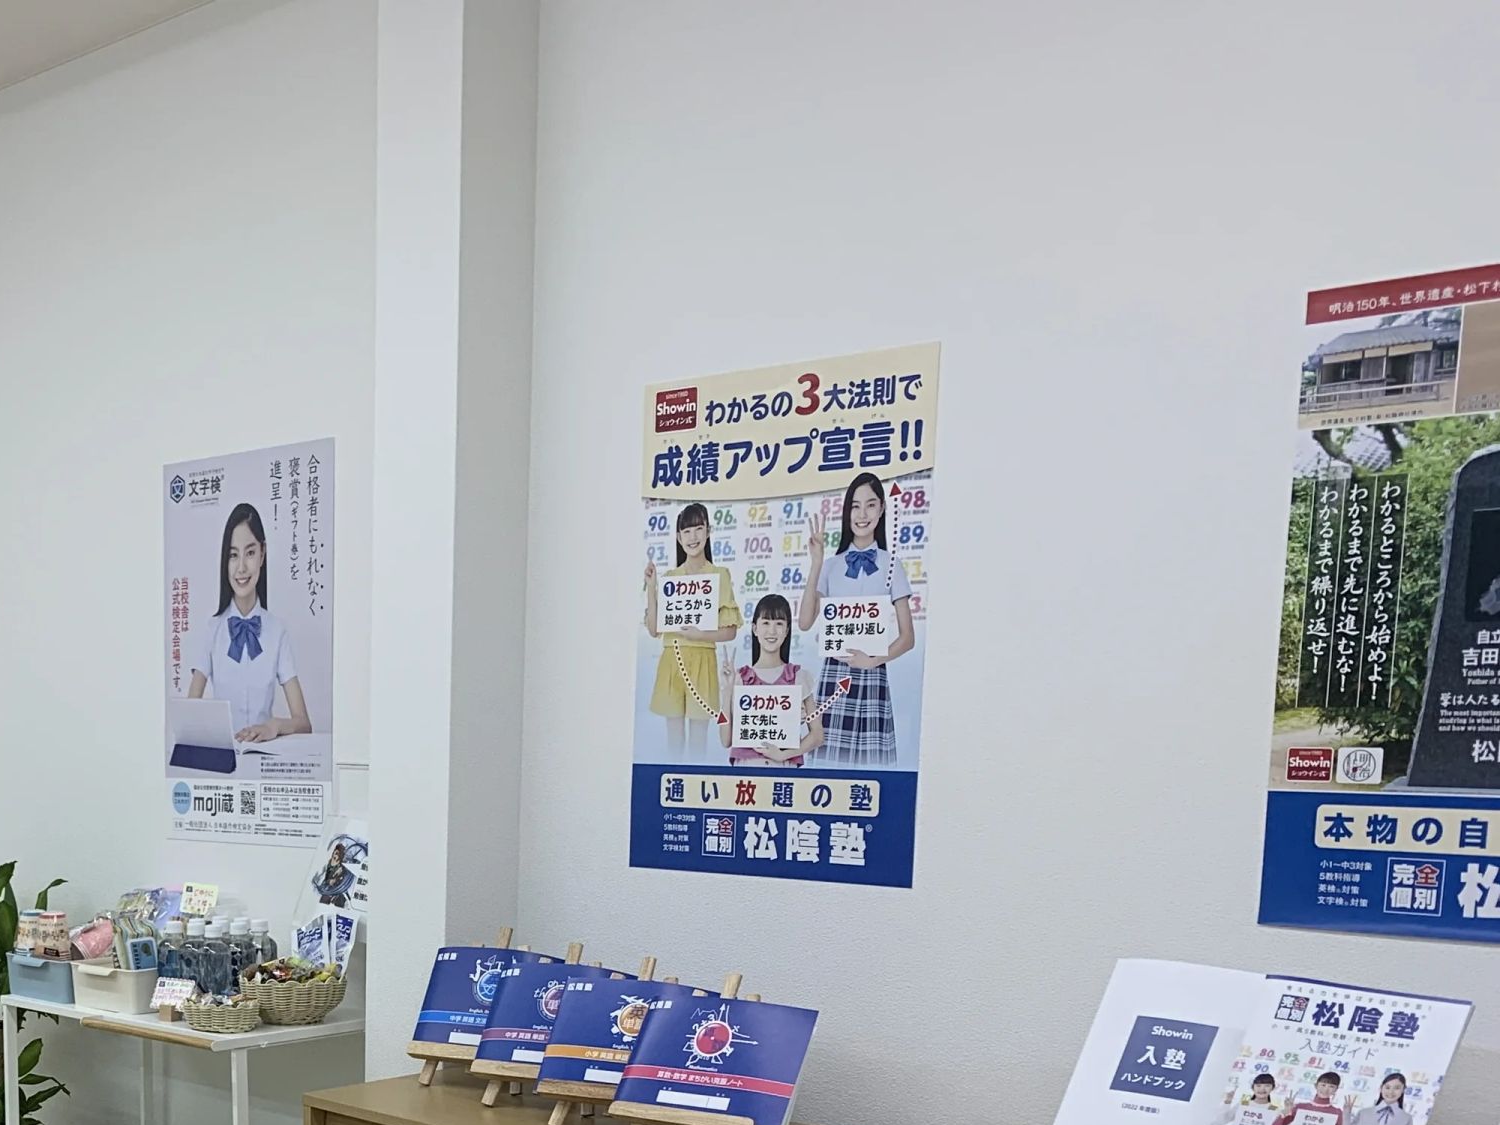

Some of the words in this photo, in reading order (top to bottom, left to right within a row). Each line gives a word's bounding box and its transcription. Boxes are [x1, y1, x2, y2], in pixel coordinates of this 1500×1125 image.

[656, 399, 697, 417] Showin
[704, 373, 924, 427] わかるの3大法則で
[188, 475, 221, 497] 文字検
[306, 454, 321, 616] 合格者にもれなく
[665, 598, 712, 612] ところから
[665, 613, 702, 626] 始めます
[825, 622, 885, 637] まで繰り返し
[824, 638, 845, 651] ます
[1462, 647, 1500, 666] 吉田
[740, 714, 778, 726] まで先に
[740, 728, 787, 741] 進みません
[1288, 757, 1331, 768] Showin
[664, 778, 873, 812] 通い放題の塾
[193, 792, 234, 817] moji蔵
[706, 817, 733, 836] 完全
[1323, 811, 1489, 850] 本物の自
[704, 835, 732, 853] 個別
[1319, 872, 1361, 883] 5教科指導
[1392, 863, 1440, 887] 完全
[1390, 886, 1438, 911] 個別
[1151, 1025, 1194, 1041] Showin
[1136, 1045, 1187, 1071] 入塾
[1299, 1037, 1380, 1061] 入塾ガイド
[1120, 1072, 1186, 1090] ハンドブック
